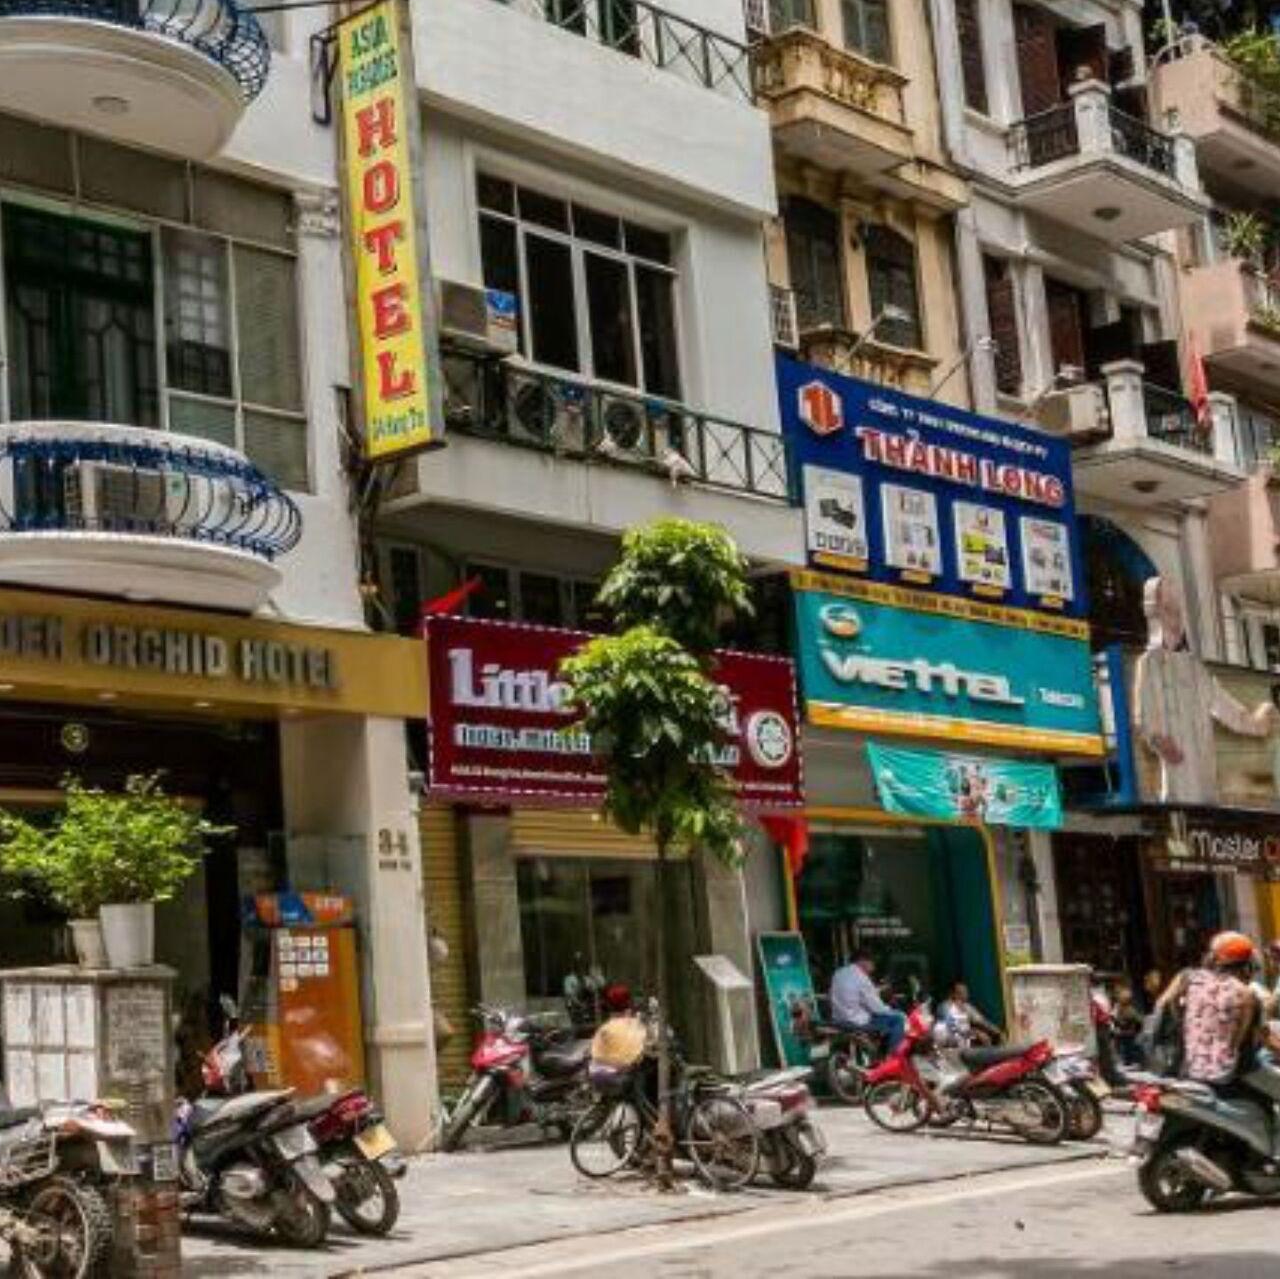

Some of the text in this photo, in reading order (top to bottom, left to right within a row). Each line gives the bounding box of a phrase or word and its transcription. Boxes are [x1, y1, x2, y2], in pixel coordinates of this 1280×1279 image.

[354, 96, 417, 404] HOTEL
[980, 458, 1064, 507] LONG
[82, 623, 229, 678] ORCHID
[241, 637, 339, 690] HOTEL
[448, 648, 578, 714] Little
